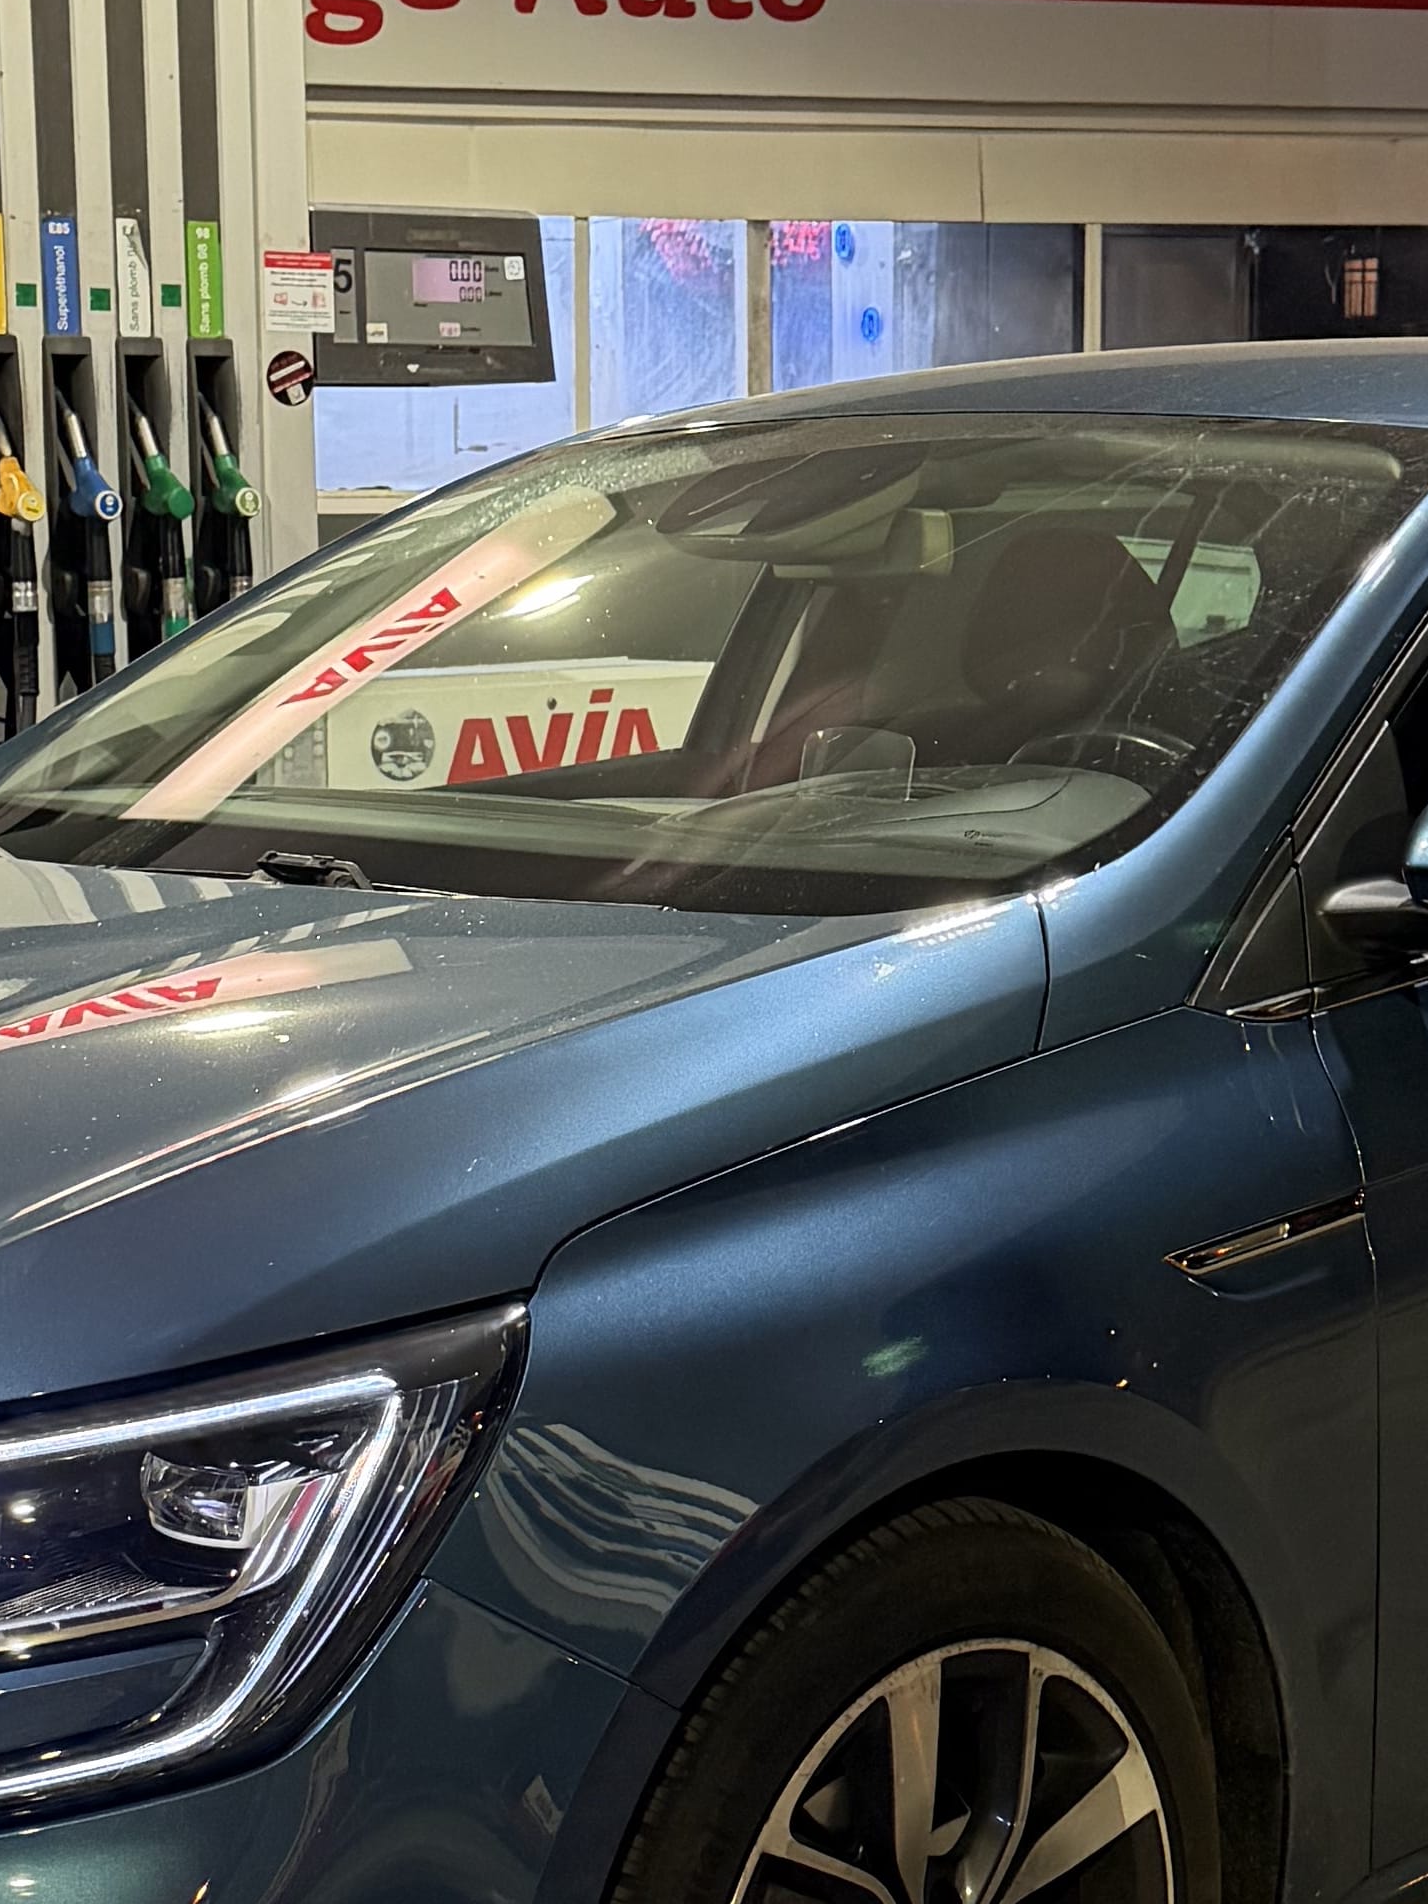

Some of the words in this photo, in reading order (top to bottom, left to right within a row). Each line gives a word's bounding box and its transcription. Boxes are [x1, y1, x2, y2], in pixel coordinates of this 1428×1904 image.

[53, 245, 68, 331] Superéthanol
[129, 260, 140, 298] plomb
[199, 262, 210, 299] plomb
[334, 258, 353, 293] 5
[129, 301, 141, 332] Sans
[199, 302, 210, 333] Sans
